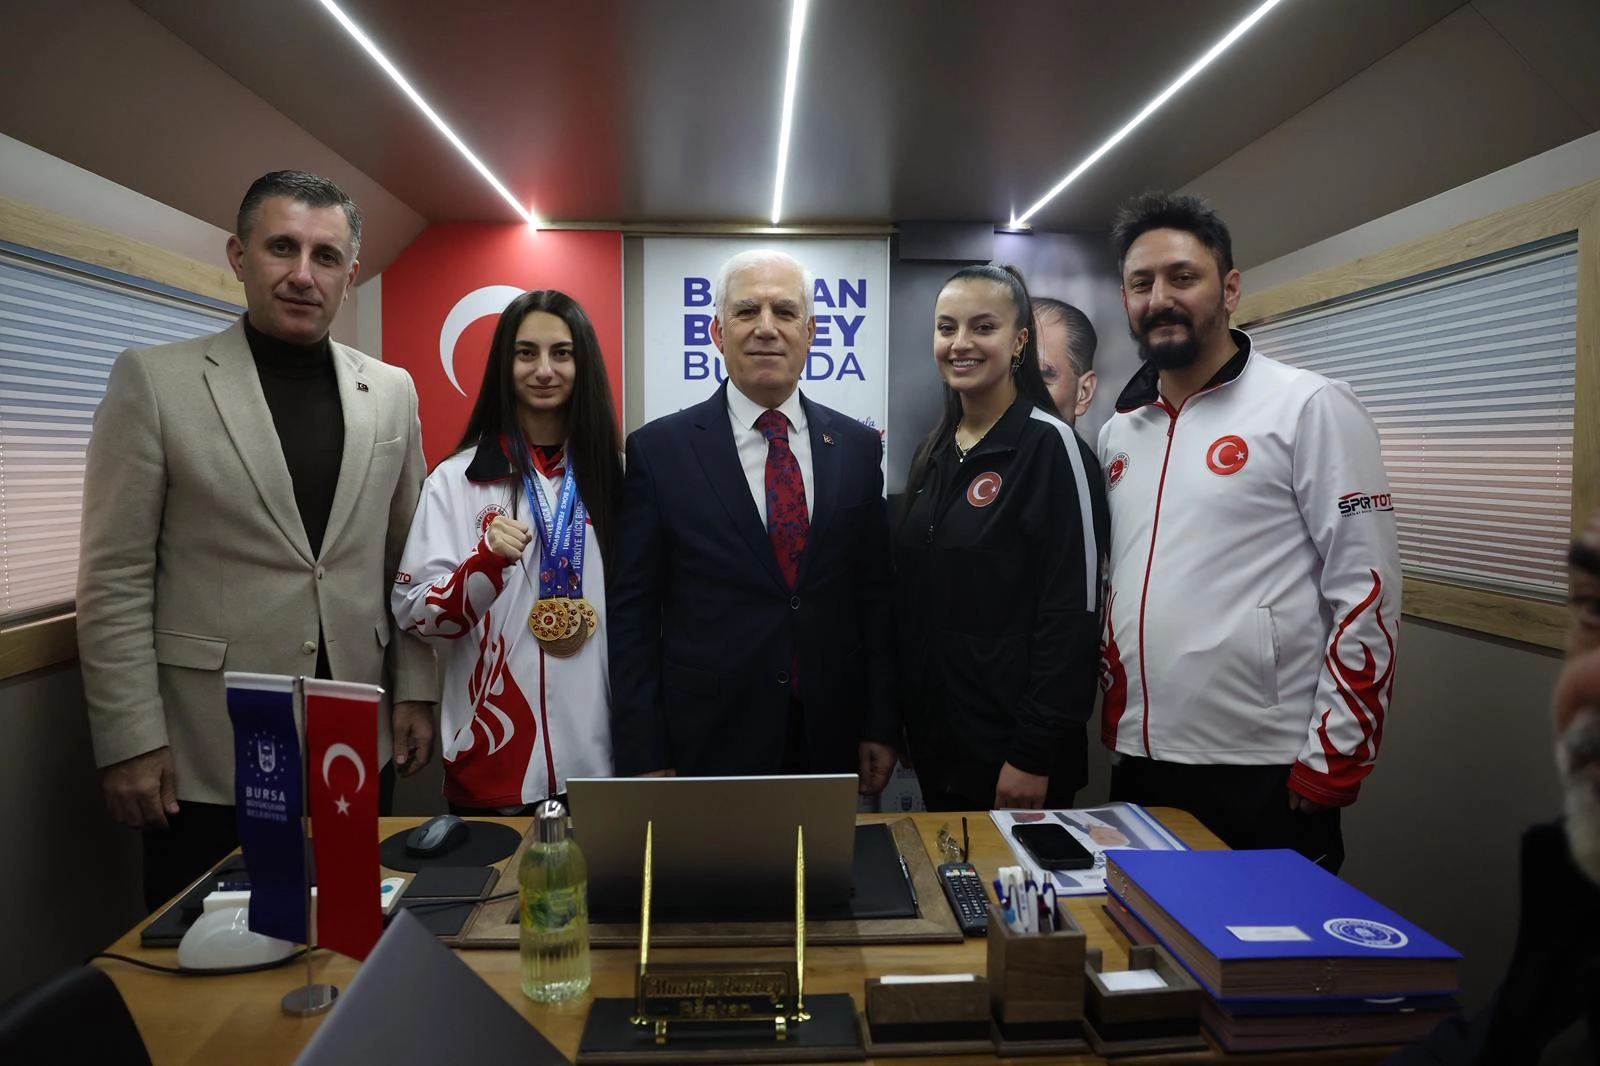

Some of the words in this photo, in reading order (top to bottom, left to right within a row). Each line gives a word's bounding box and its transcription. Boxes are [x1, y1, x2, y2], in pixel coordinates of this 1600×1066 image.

[684, 277, 867, 308] BAN
[684, 314, 866, 347] BEY
[550, 511, 566, 557] FEDERASYONU
[246, 786, 286, 803] BURSA
